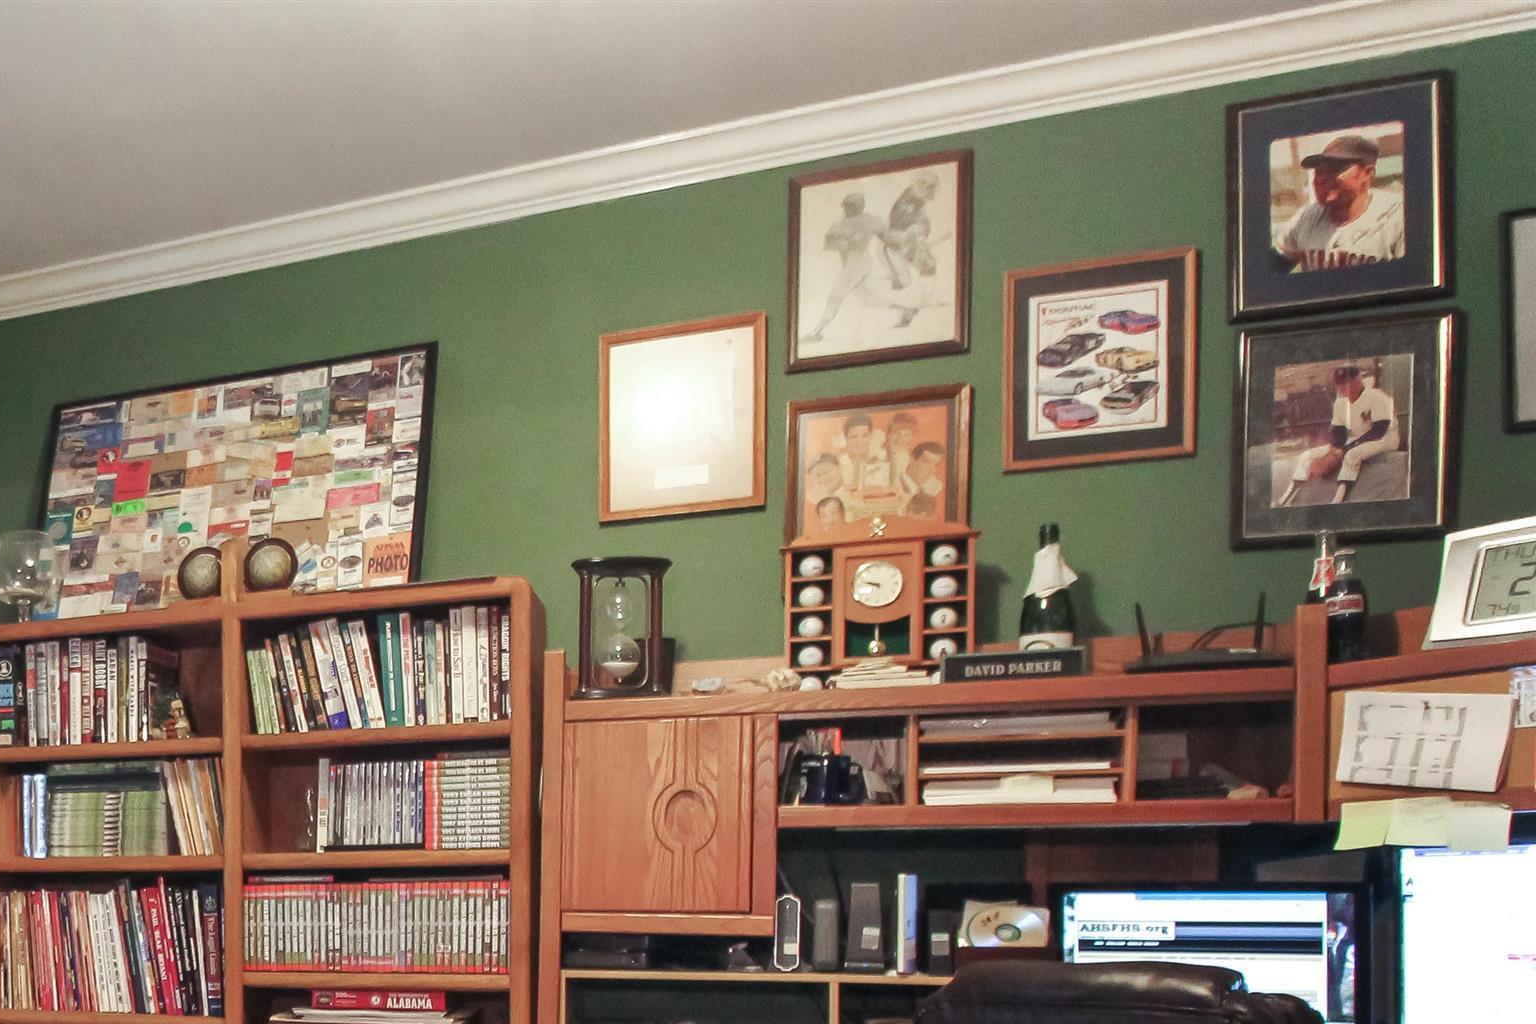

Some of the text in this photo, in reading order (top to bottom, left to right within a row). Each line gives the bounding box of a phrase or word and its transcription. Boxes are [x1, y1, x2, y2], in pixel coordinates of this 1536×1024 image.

[367, 553, 408, 574] PHOTO
[453, 629, 461, 647] How
[108, 651, 116, 681] SABAN
[451, 657, 461, 672] Say
[964, 660, 1062, 677] DAVID PARKER
[94, 663, 106, 689] BOBBY
[150, 908, 160, 927] PAUL
[157, 953, 168, 980] BRYANT
[386, 998, 432, 1009] ALABAMA
